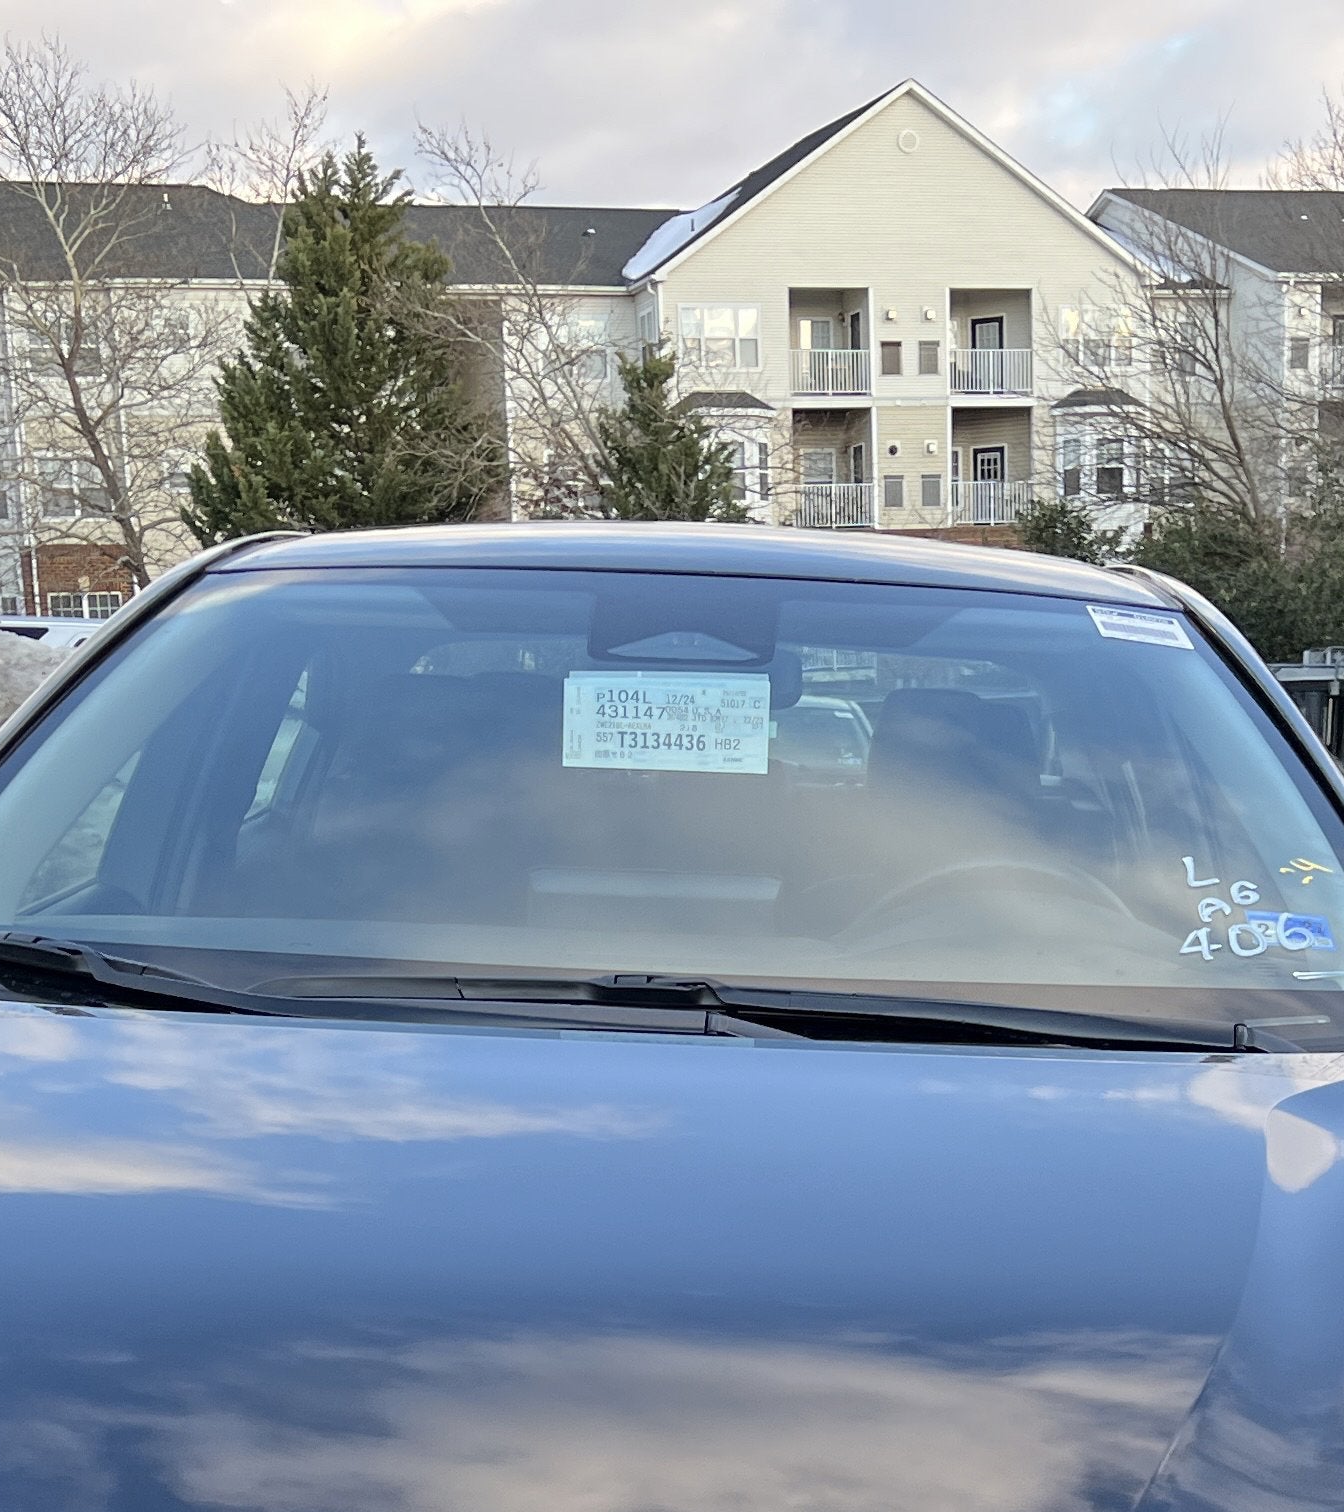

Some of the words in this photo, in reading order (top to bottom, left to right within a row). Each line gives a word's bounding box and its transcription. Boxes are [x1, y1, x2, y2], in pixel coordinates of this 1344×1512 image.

[596, 704, 666, 720] 431147
[617, 731, 706, 751] T3134436
[714, 738, 741, 751] HB2
